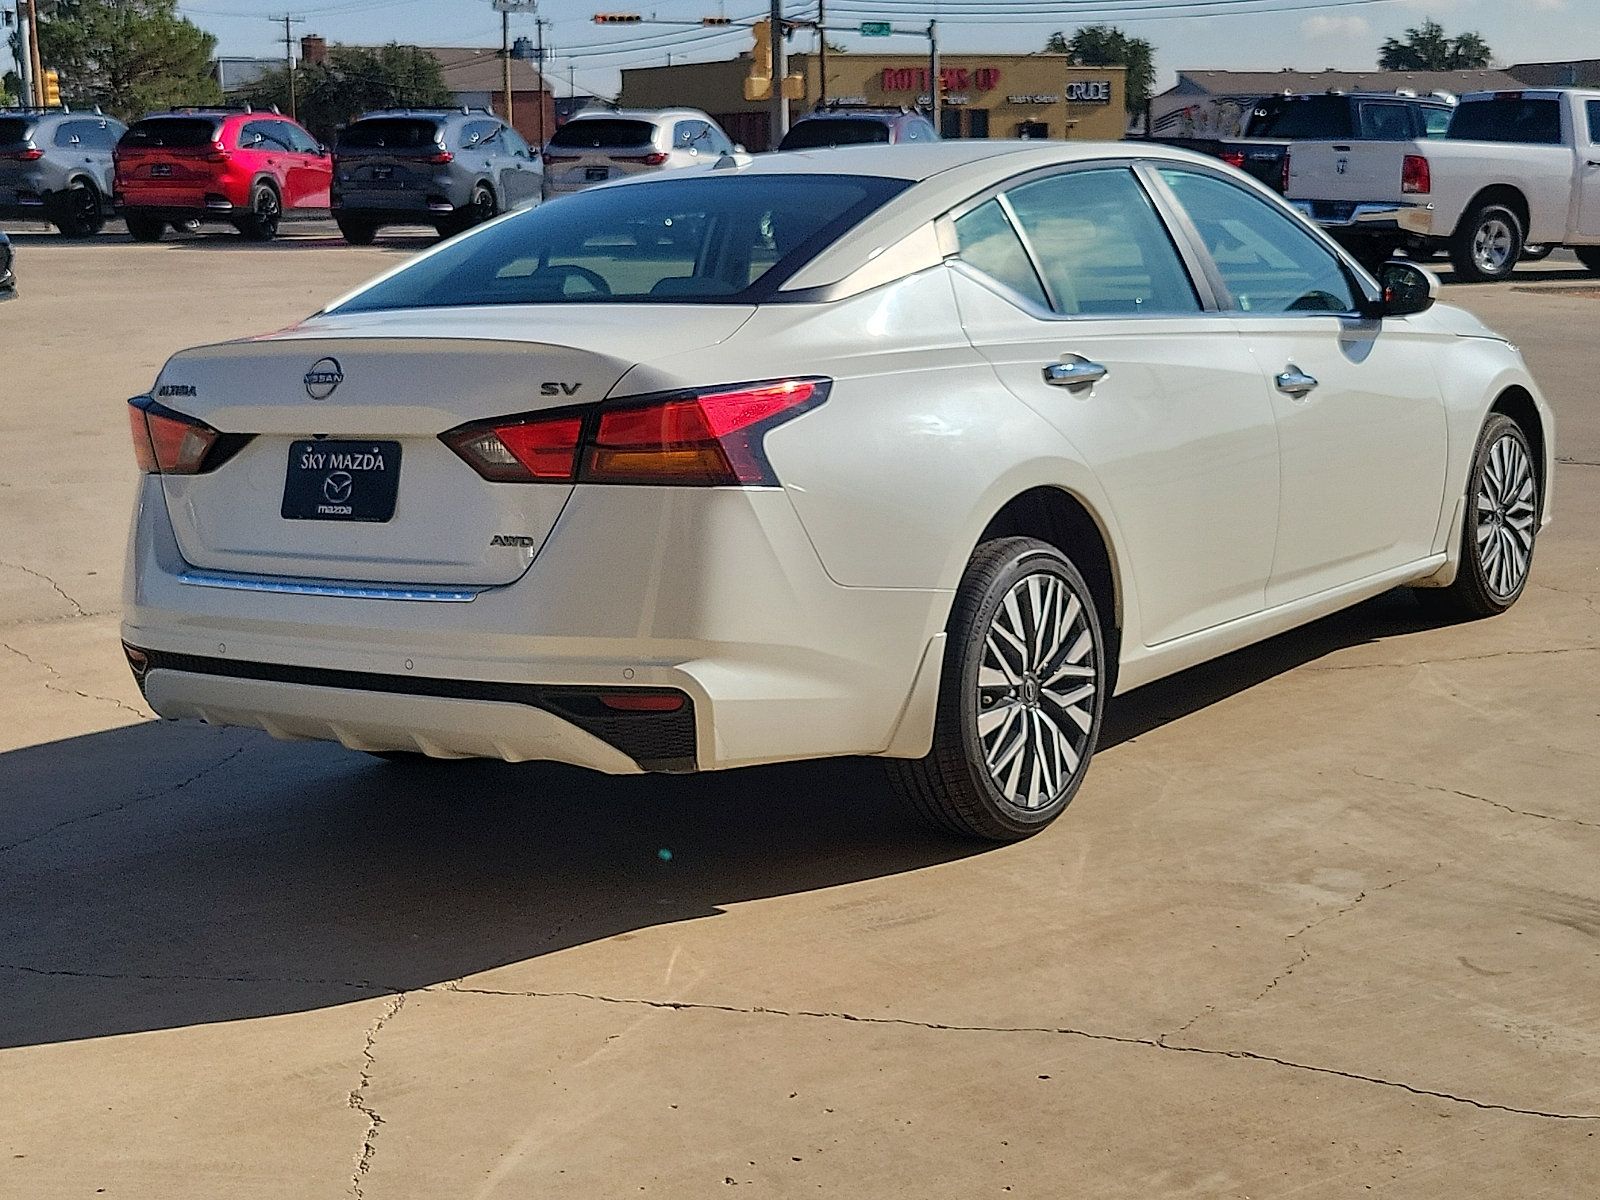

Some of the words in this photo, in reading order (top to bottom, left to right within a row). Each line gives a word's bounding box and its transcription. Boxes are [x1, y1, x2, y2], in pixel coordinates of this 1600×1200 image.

[883, 67, 970, 92] BOTTMS
[976, 67, 1000, 91] UP
[1065, 82, 1110, 100] CRUDE
[540, 382, 581, 396] SV
[301, 454, 326, 469] SKY
[330, 453, 385, 471] MAZDA
[318, 505, 352, 515] mazda
[490, 535, 534, 547] AWD
